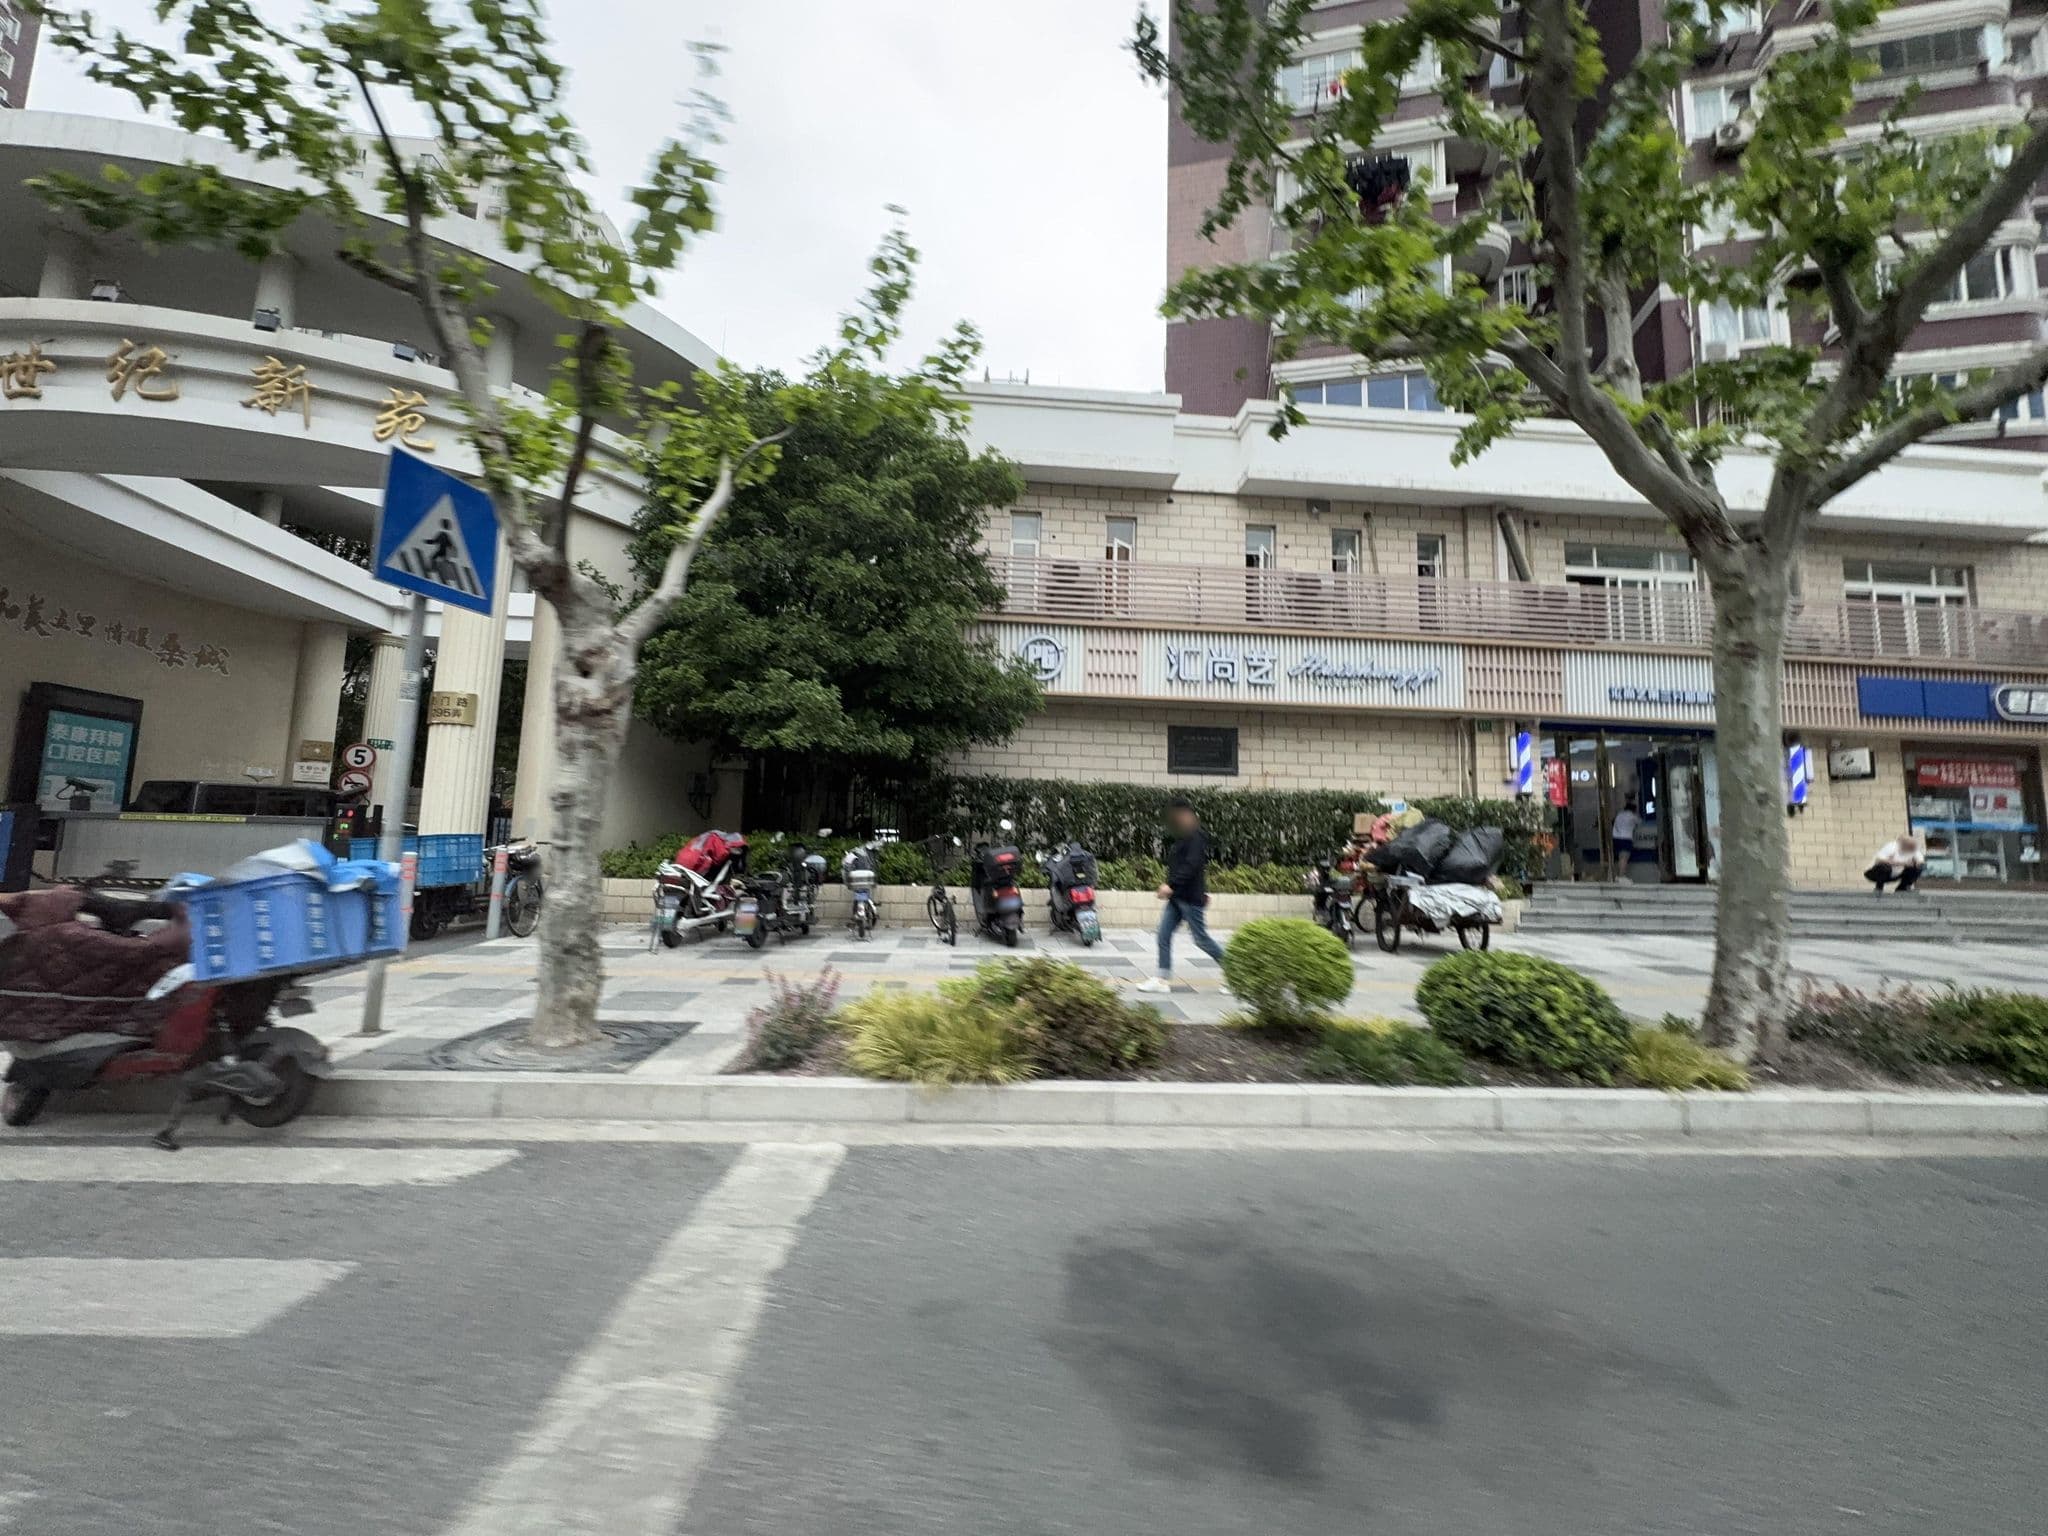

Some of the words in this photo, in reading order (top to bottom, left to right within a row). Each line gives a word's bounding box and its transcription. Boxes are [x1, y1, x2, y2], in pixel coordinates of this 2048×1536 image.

[1166, 643, 1278, 685] 汇尚艺
[48, 743, 122, 766] 口腔医院
[353, 749, 367, 765] 5
